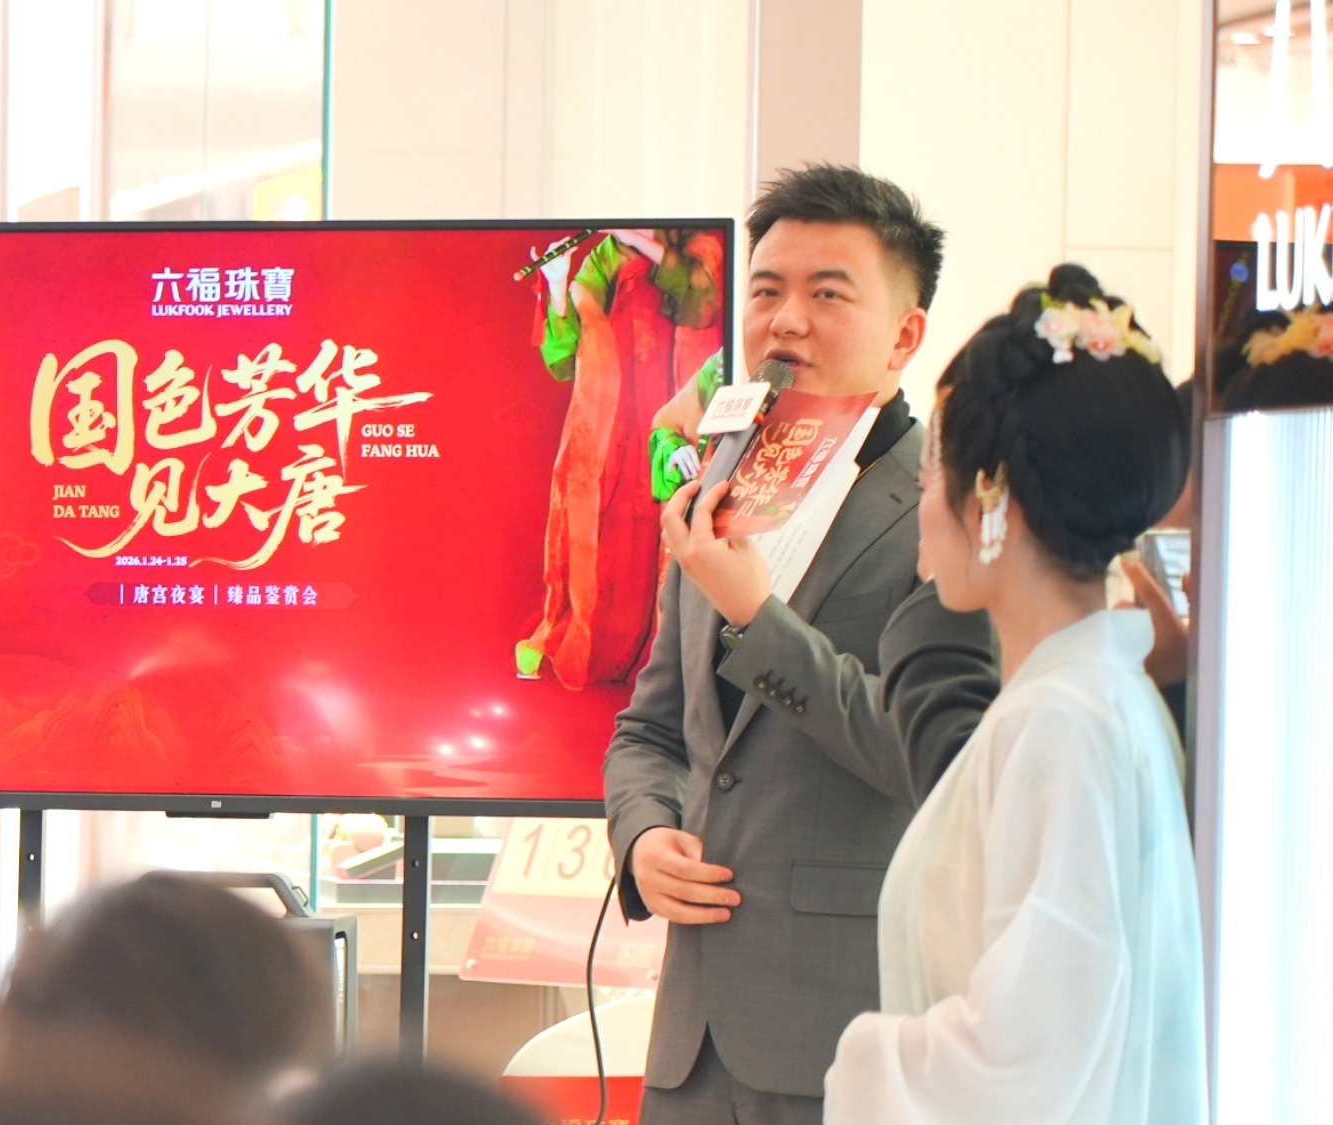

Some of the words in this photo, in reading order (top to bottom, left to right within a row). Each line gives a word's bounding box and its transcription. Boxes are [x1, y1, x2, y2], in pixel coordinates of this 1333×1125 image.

[151, 266, 295, 303] 六福珠寶
[151, 304, 215, 316] LUKFOOK
[216, 304, 293, 318] JEWELLERY
[30, 339, 433, 482] 国色芳华
[361, 424, 393, 438] GUO
[396, 424, 415, 438] SE
[361, 444, 402, 458] FANG
[405, 444, 440, 458] HUA
[53, 485, 86, 500] JIAN
[53, 444, 368, 571] 见大唐
[53, 505, 75, 519] DA
[80, 505, 120, 519] TANG
[114, 556, 188, 567] 2026.1.24-1.25
[133, 584, 205, 604] 唐宫夜宴
[227, 584, 318, 605] 臻品鉴赏会
[523, 823, 615, 880] 13
